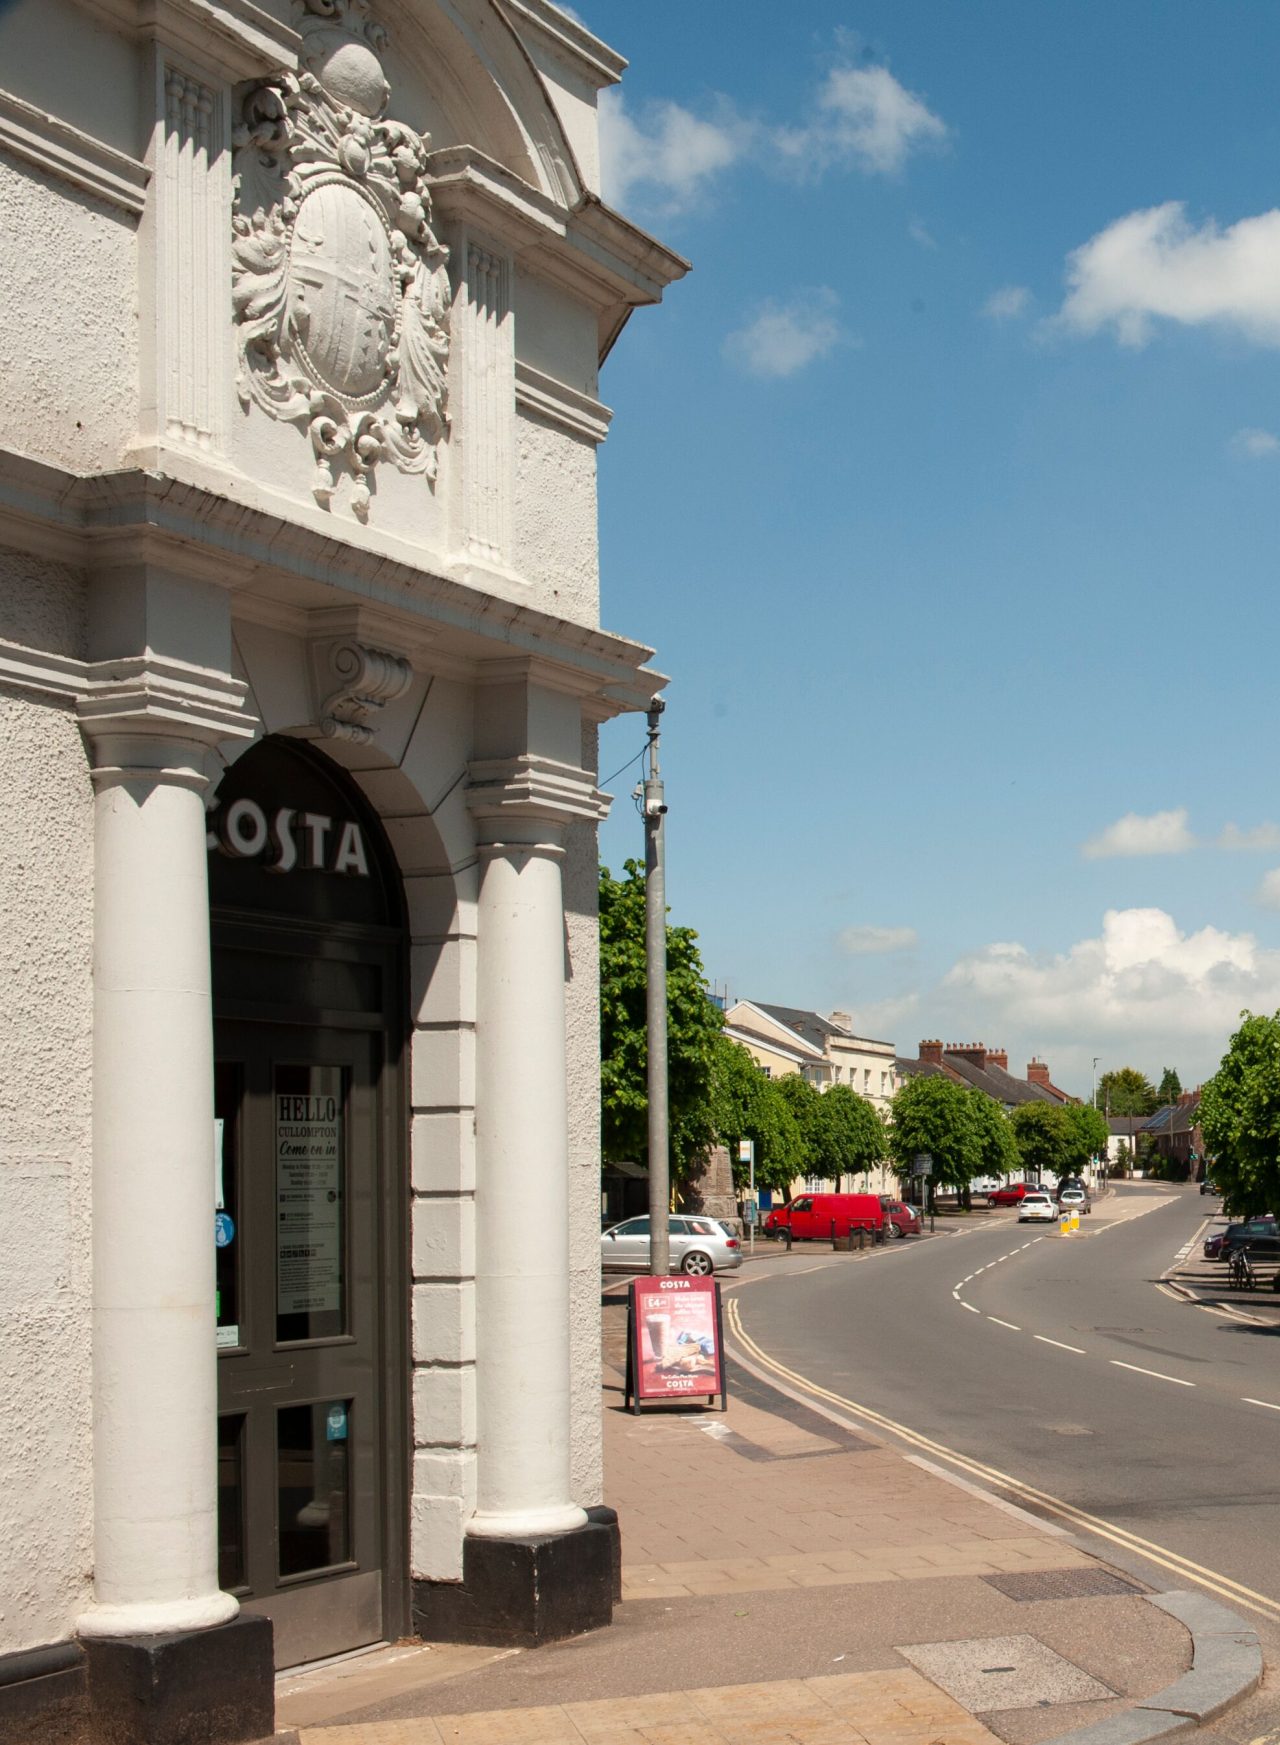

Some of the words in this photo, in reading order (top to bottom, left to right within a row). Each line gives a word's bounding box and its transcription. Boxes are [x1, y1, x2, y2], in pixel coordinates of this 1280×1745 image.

[279, 1096, 336, 1122] HELLO
[278, 1126, 337, 1138] CULLOMPTON
[279, 1140, 308, 1156] Come
[310, 1144, 324, 1156] on
[325, 1141, 337, 1156] in
[660, 1280, 690, 1289] COSTA
[666, 1380, 694, 1388] COSTA
